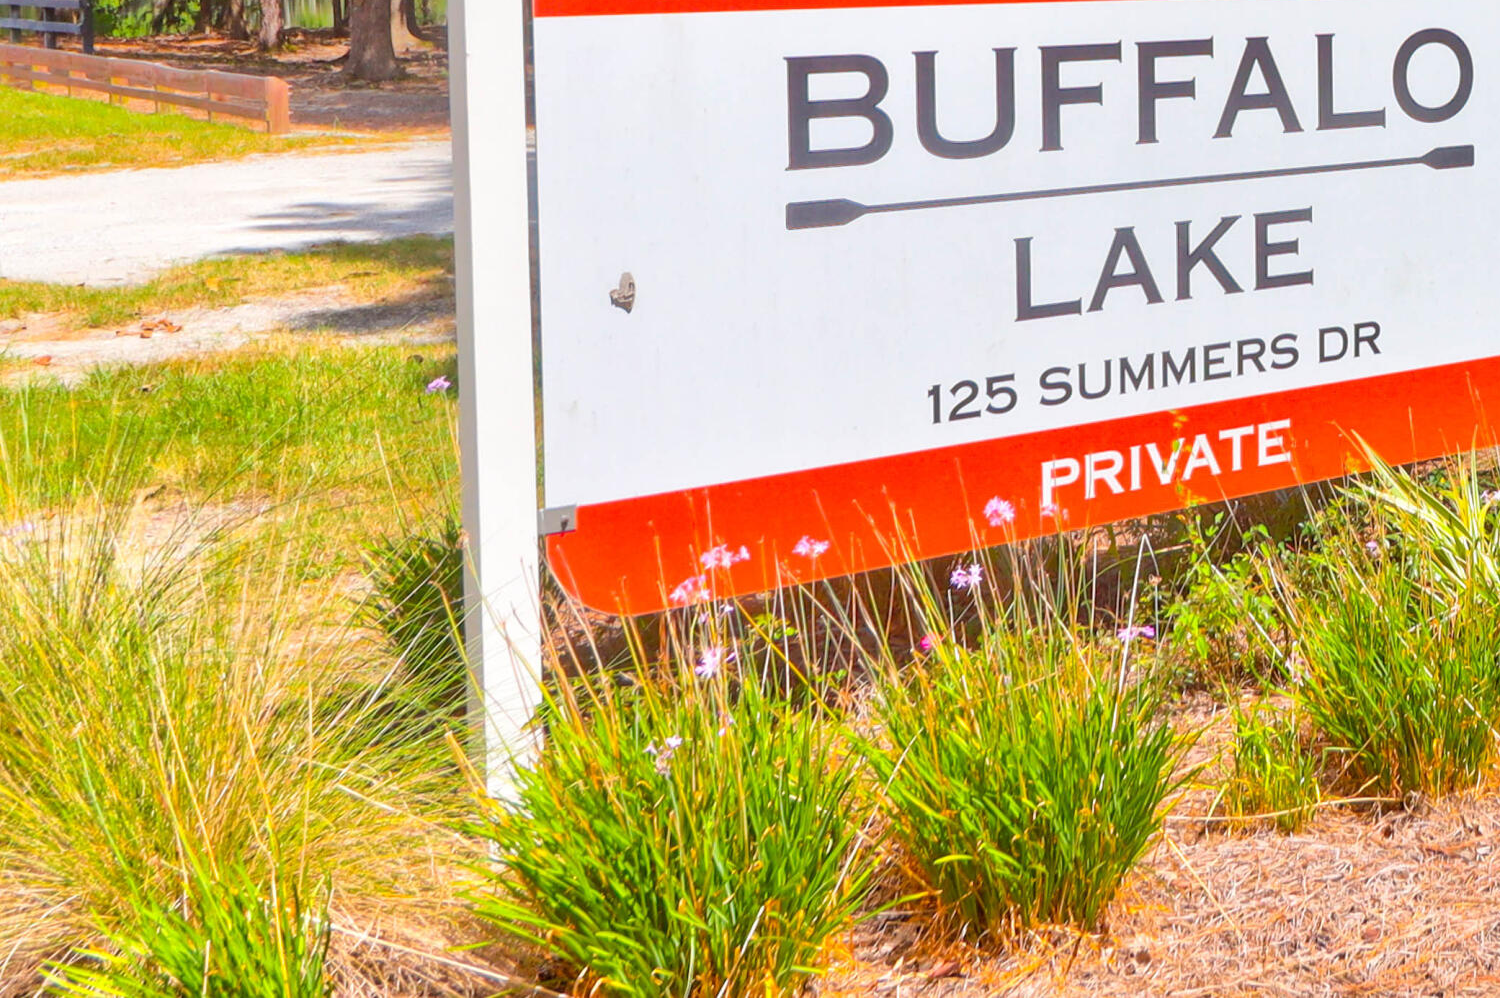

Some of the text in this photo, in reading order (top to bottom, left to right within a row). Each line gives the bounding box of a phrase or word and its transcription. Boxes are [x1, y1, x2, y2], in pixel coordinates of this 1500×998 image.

[783, 27, 1474, 171] BUFFALO
[1014, 206, 1314, 322] LAKE
[927, 321, 1382, 424] 125 SUMMERS DR
[1040, 418, 1292, 507] PRIVATE
